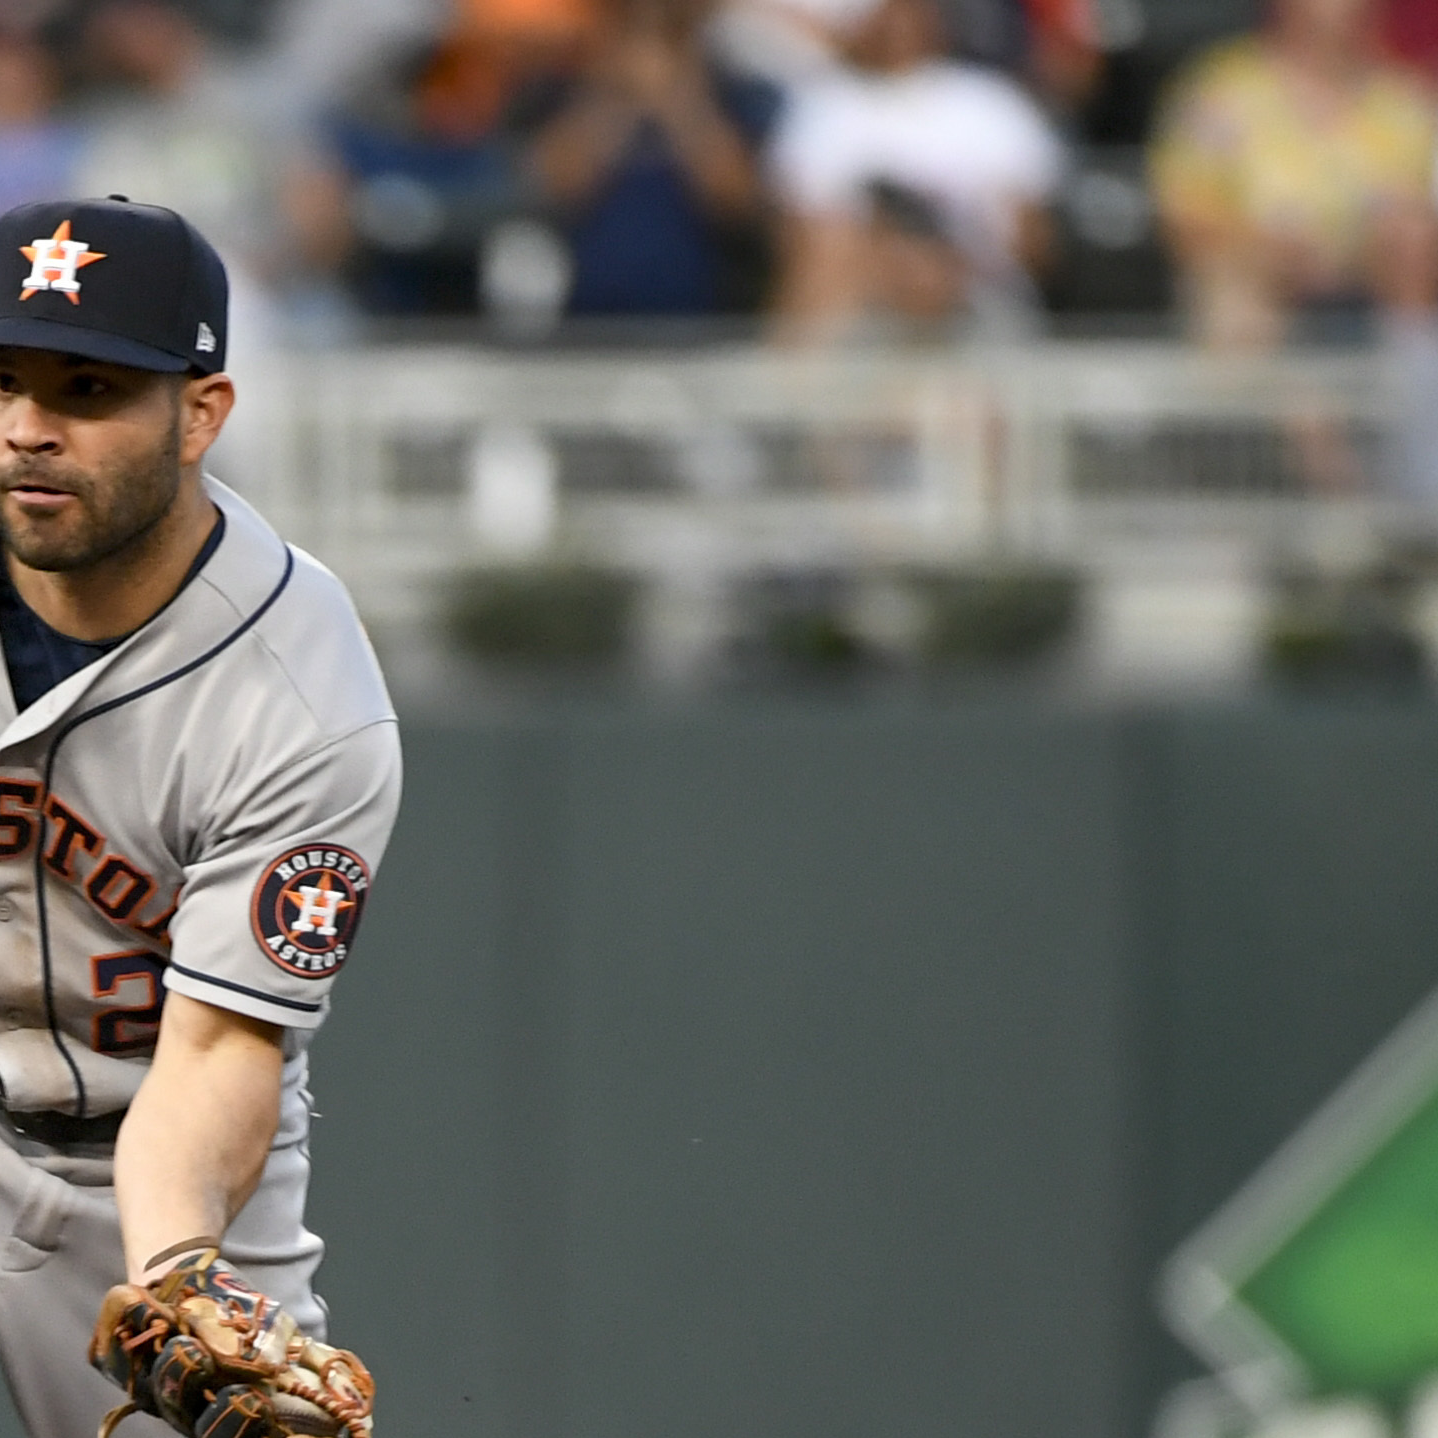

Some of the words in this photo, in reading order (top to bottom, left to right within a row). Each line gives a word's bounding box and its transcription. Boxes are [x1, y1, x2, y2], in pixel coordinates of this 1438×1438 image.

[22, 238, 90, 292] H
[275, 850, 369, 892] HOUSTON
[291, 885, 346, 936] H
[265, 934, 347, 970] ASTROS
